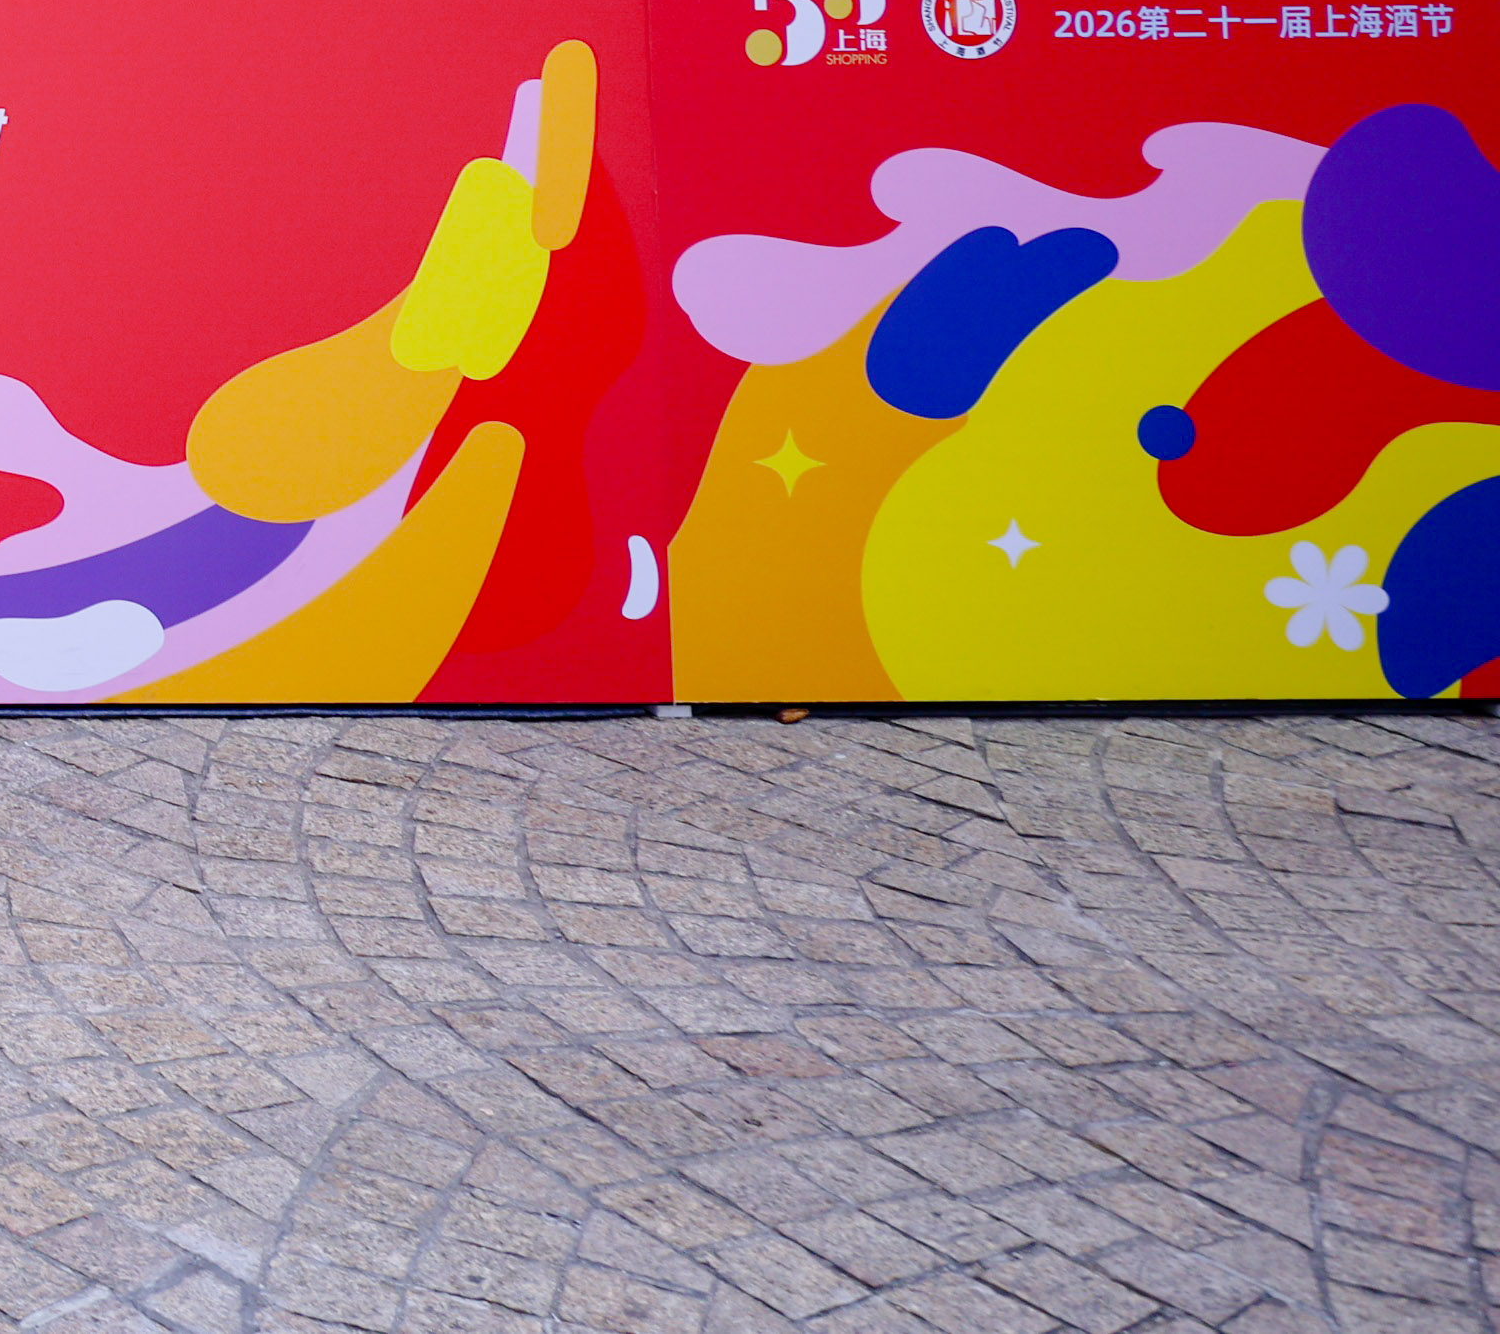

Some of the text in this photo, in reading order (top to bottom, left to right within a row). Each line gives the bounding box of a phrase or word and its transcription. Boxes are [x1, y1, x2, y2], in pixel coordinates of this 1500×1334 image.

[1053, 3, 1455, 42] 2026第二十一届上海酒节
[832, 29, 888, 52] 上海
[826, 54, 888, 65] SHOPPING
